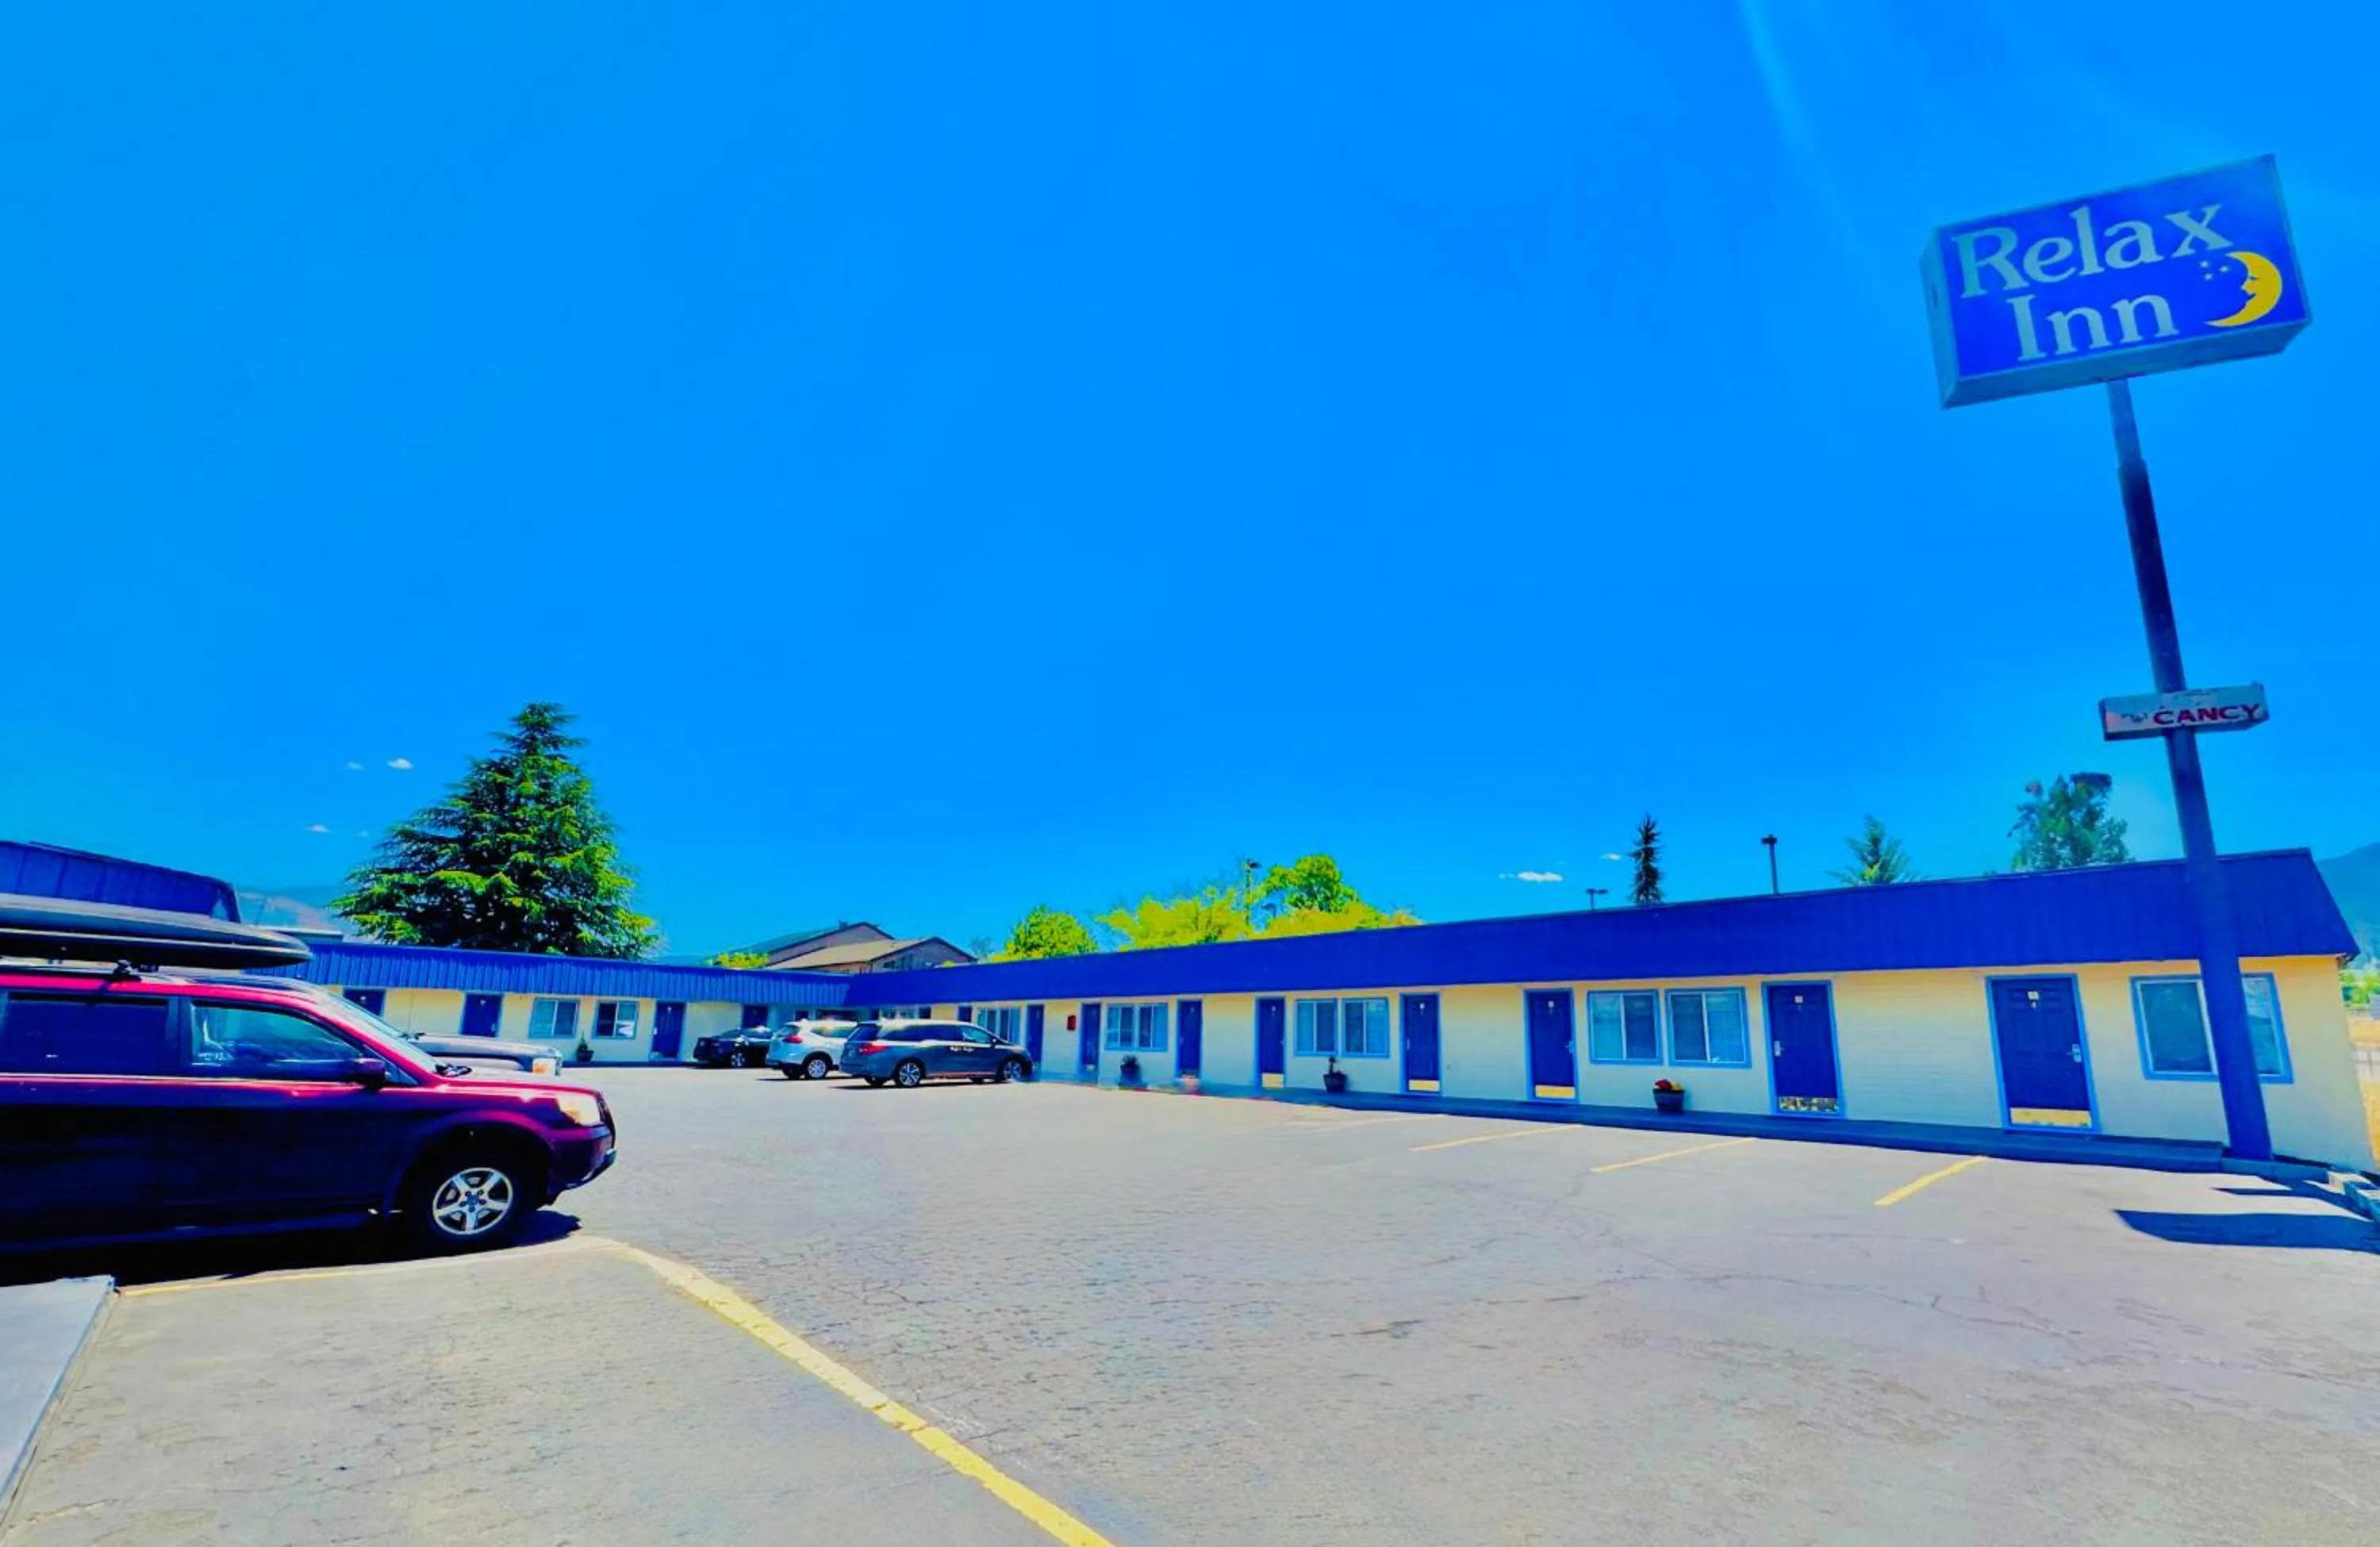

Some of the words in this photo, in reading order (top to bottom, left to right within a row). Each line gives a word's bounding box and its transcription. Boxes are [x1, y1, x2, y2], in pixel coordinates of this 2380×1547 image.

[1951, 205, 2233, 298] Relax
[2006, 294, 2179, 362] Inn
[2120, 703, 2260, 725] CANCY
